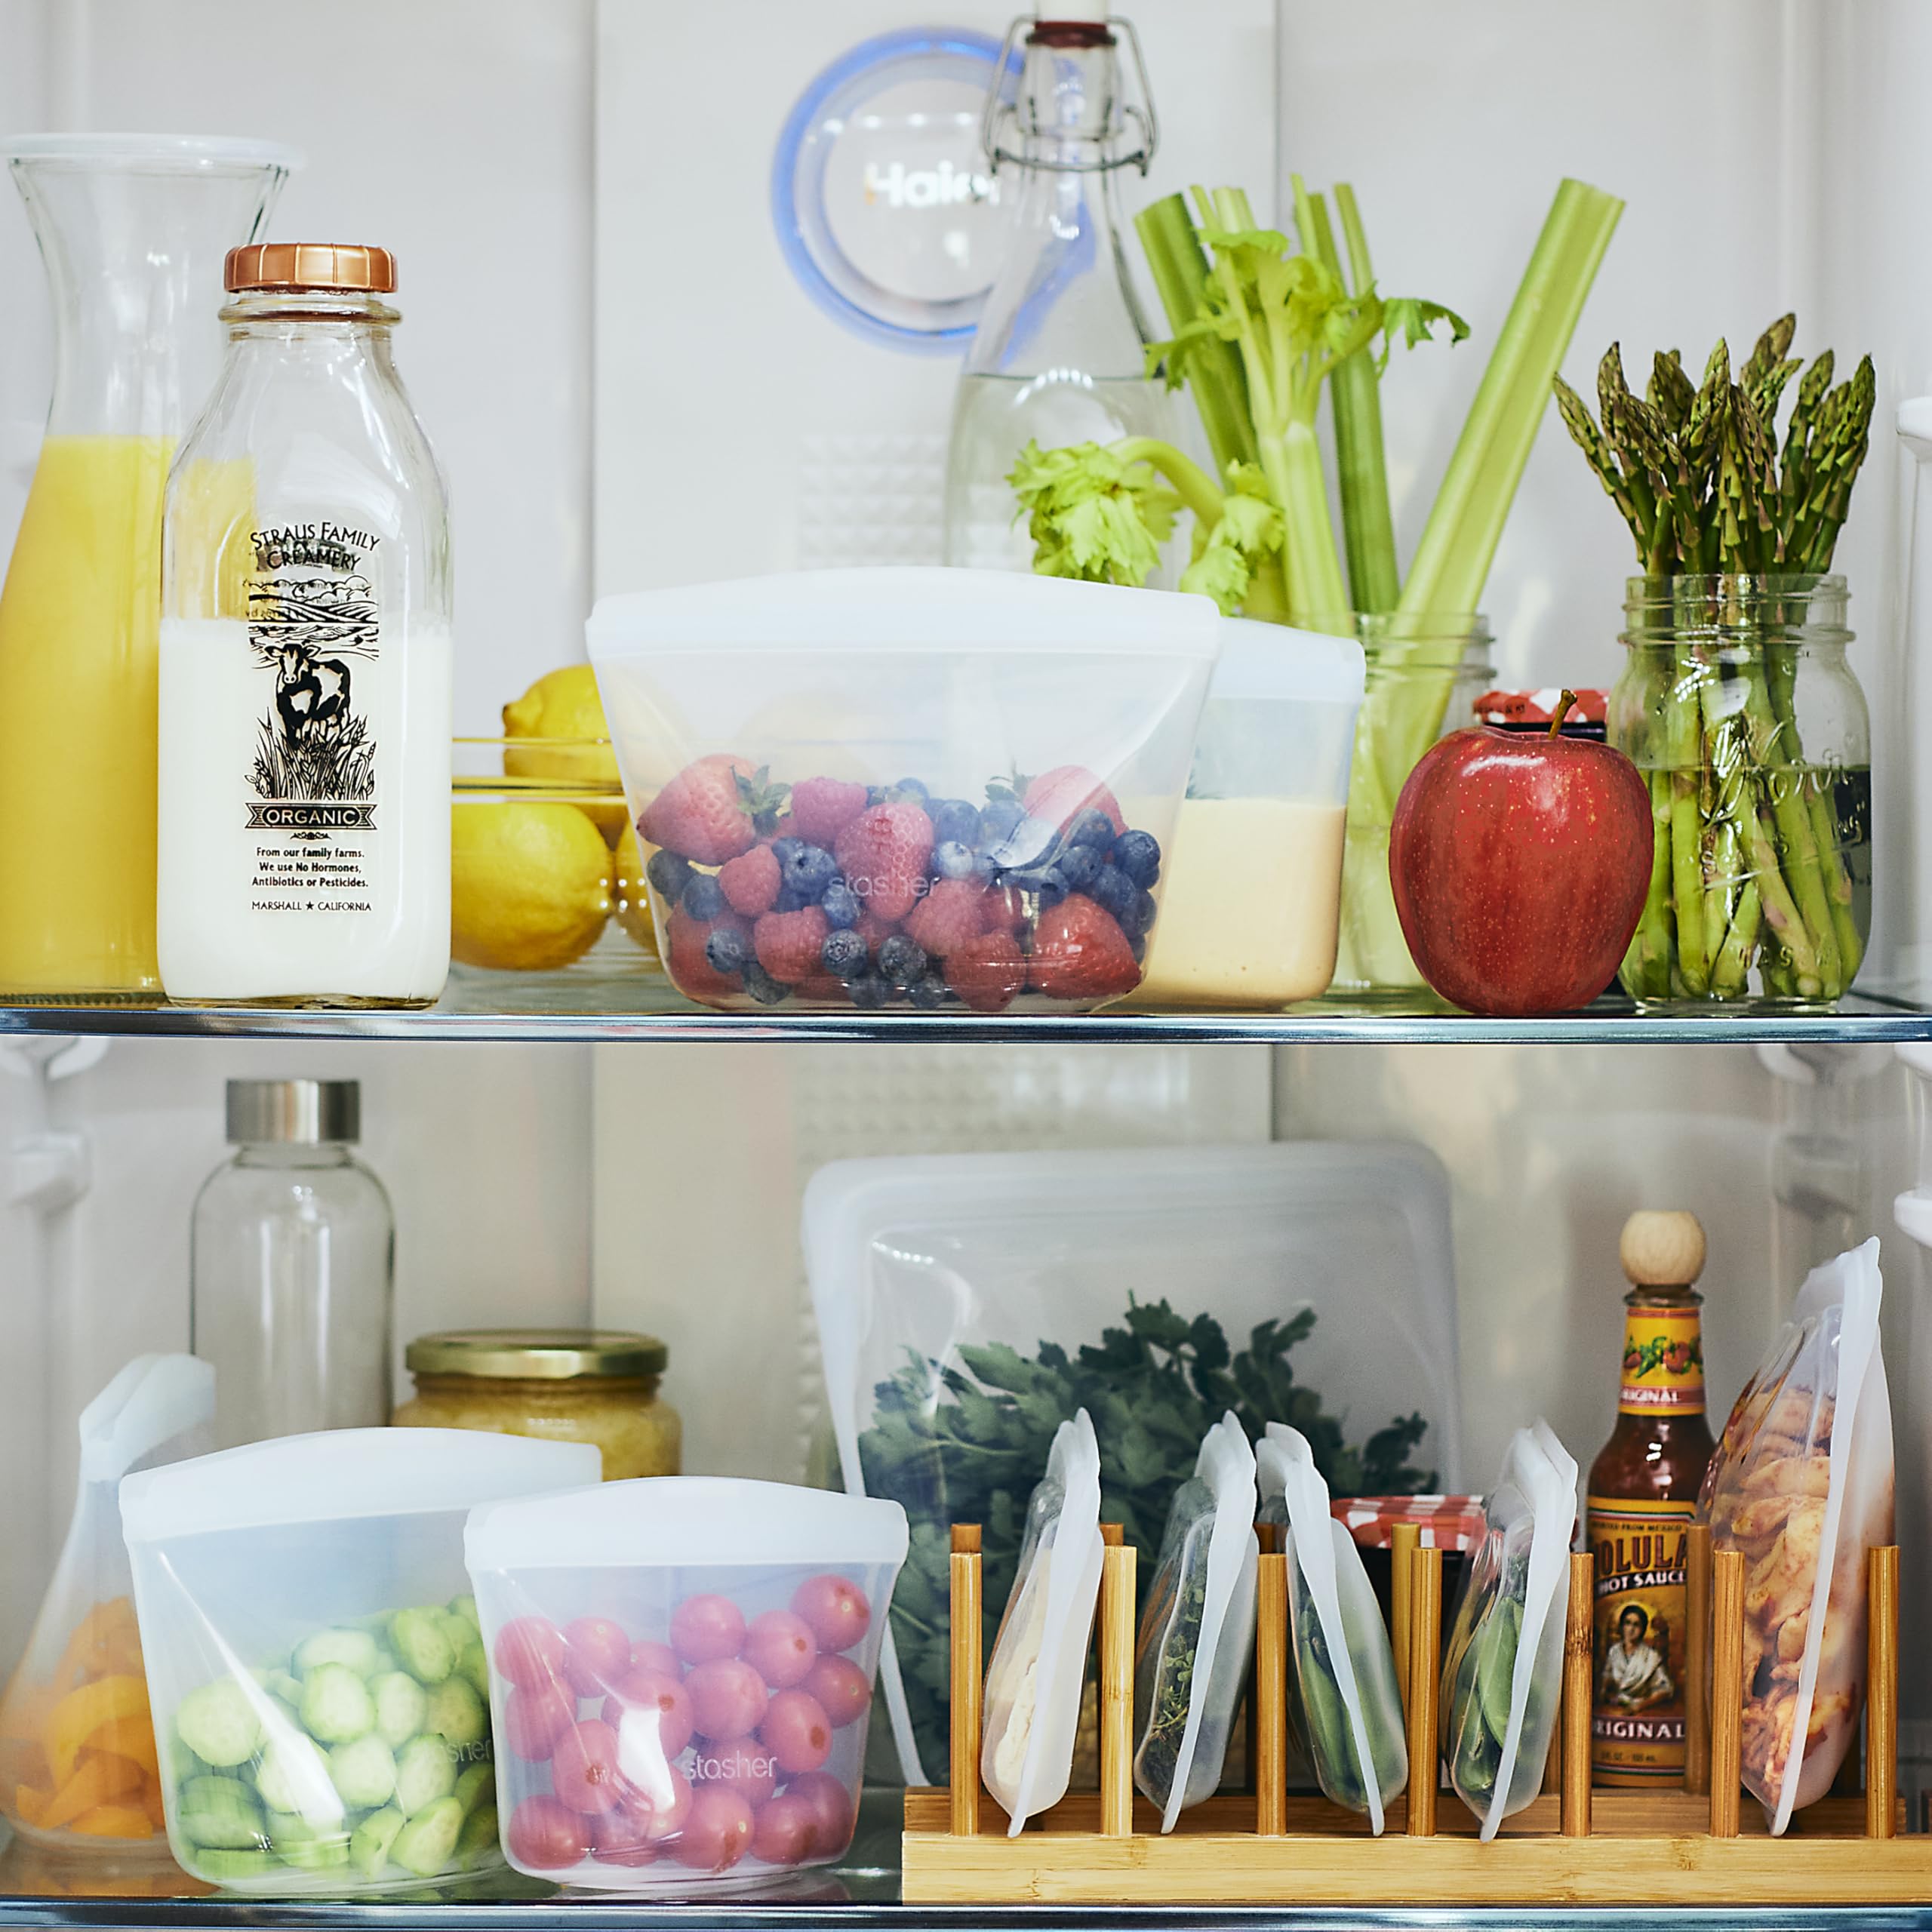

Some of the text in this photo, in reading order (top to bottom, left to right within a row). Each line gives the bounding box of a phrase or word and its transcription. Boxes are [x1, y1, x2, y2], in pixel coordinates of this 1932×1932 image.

[251, 521, 380, 552] STRAUS FAMILY
[266, 549, 361, 571] CREAMERY
[266, 809, 356, 825] ORGANIC
[257, 847, 365, 860] From our family farms.
[259, 862, 362, 874] We use No Hormones,
[252, 876, 369, 888] Antibiotics or Pesticides.
[829, 868, 941, 898] stasher
[251, 901, 372, 911] MARSHALL CALIFORNIA
[1620, 1389, 1678, 1403] RIGINAL
[1596, 1534, 1687, 1576] OLULA
[1598, 1575, 1629, 1594] HOT
[1594, 1719, 1685, 1739] RIGINAL
[442, 1739, 492, 1764] sher
[686, 1749, 777, 1780] stasher
